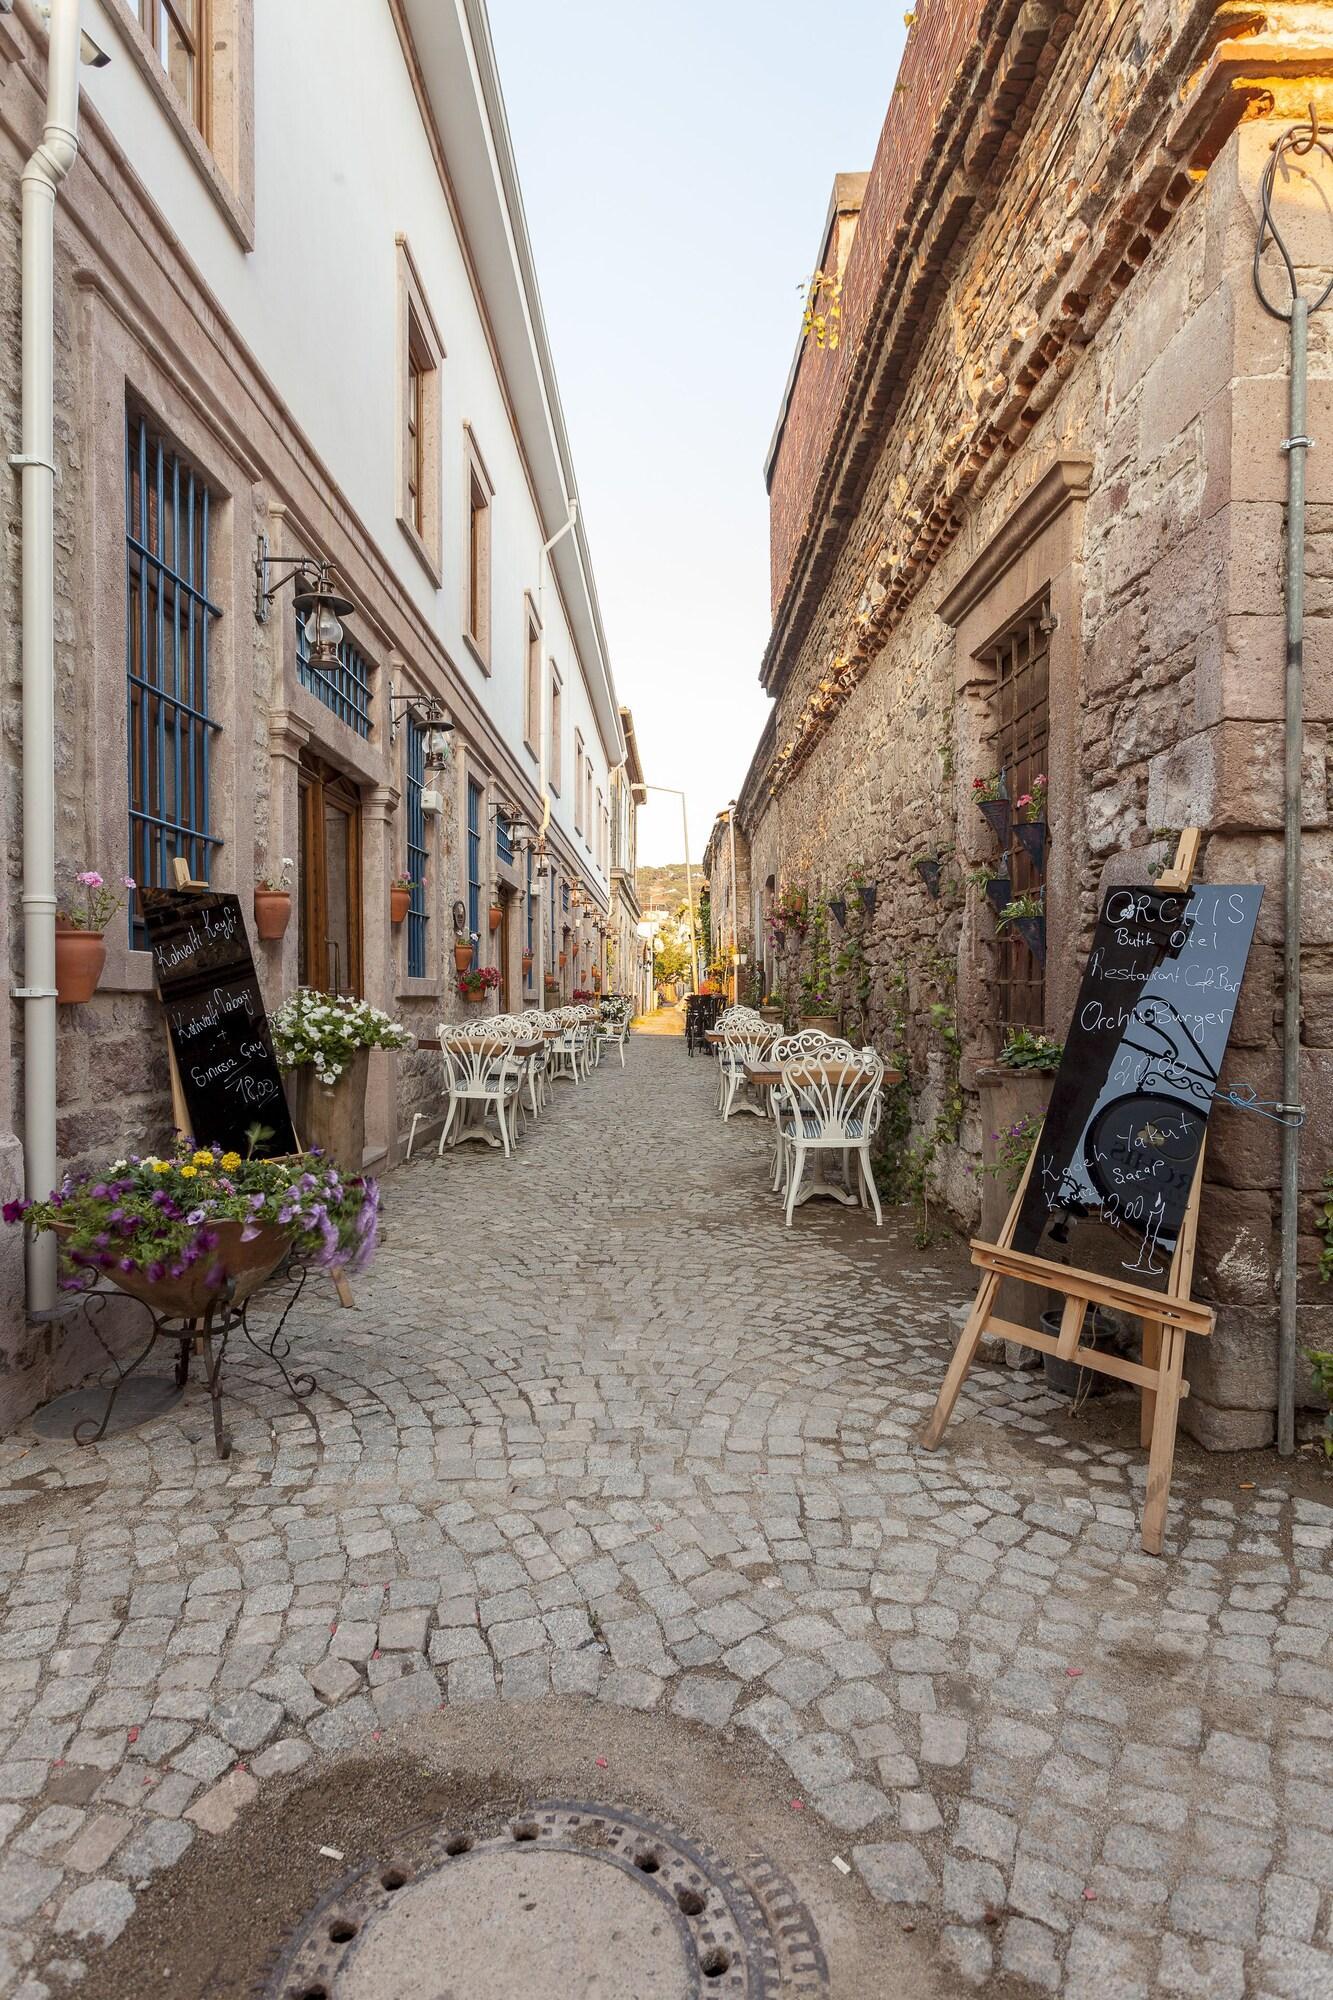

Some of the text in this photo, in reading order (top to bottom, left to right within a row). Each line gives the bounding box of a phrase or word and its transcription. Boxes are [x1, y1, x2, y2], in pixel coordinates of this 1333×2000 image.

[1106, 890, 1244, 926] ORCHIS
[1115, 928, 1217, 949] Butik Otel
[1091, 947, 1180, 982] Restaurant
[1081, 1000, 1233, 1043] Orchis Burger
[240, 1041, 268, 1059] Çay
[1100, 1193, 1144, 1228] 12,00
